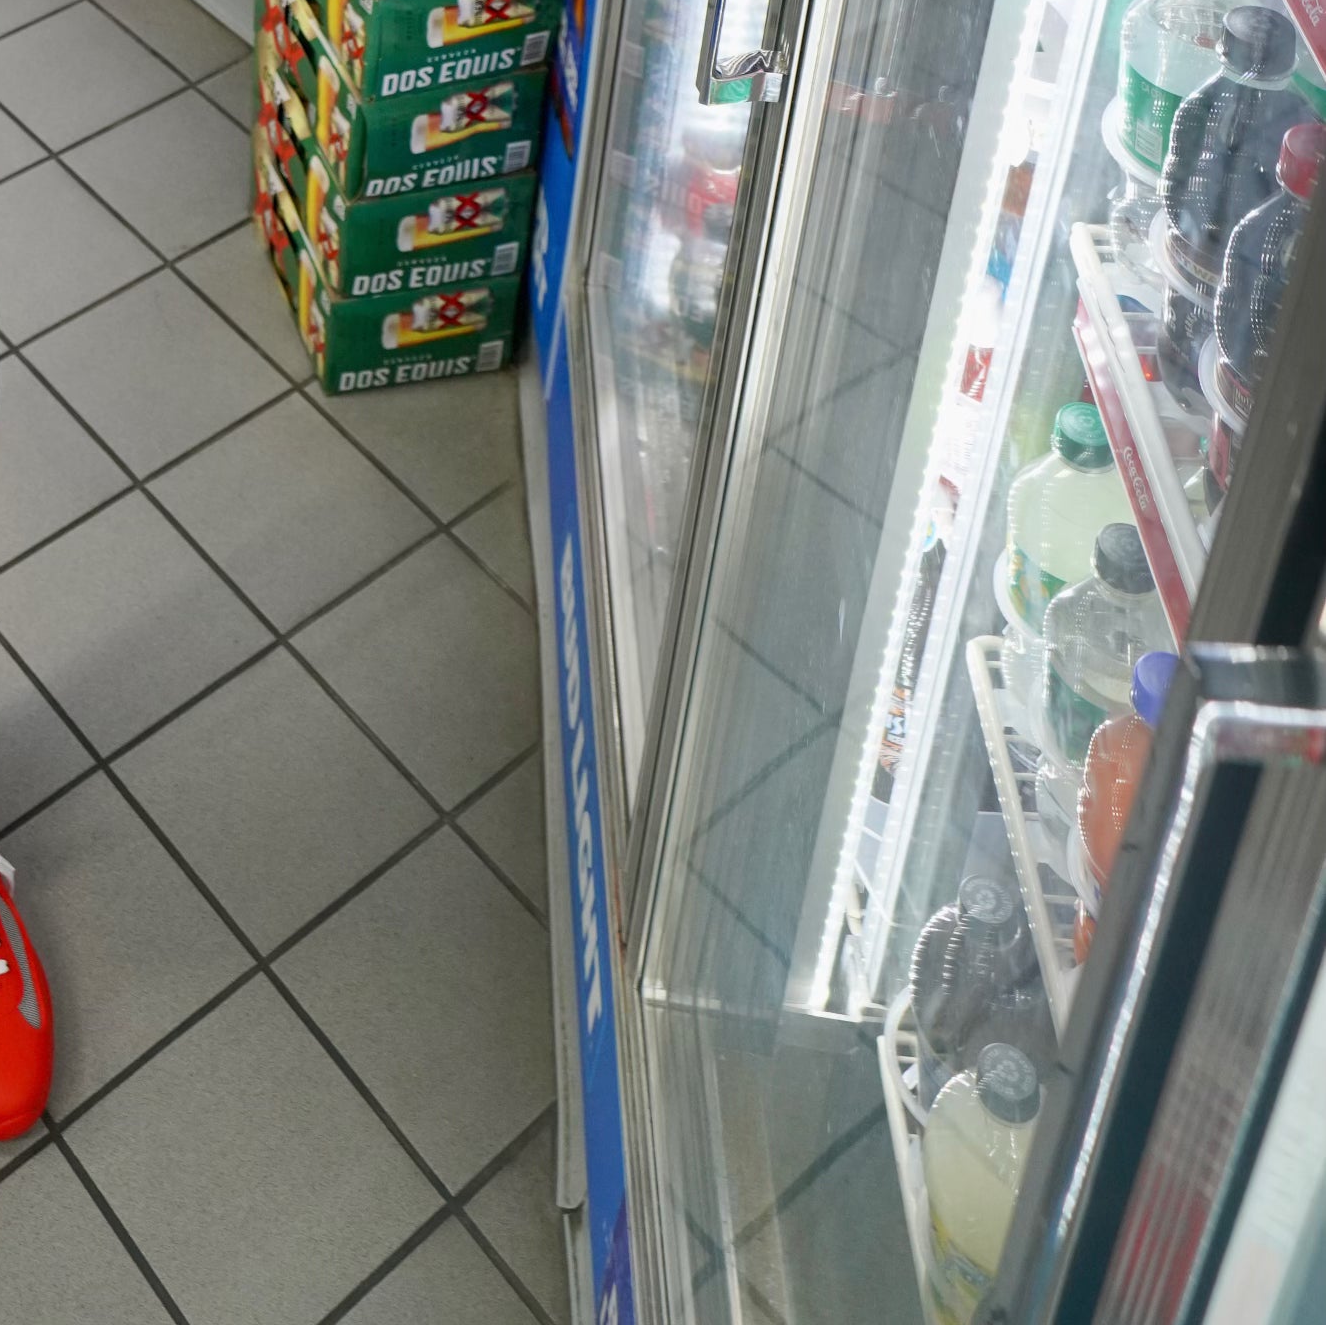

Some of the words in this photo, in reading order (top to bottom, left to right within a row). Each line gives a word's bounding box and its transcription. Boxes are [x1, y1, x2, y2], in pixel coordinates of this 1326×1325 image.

[381, 65, 435, 97] DOS
[439, 48, 516, 83] EQUIS
[365, 172, 418, 198] DOS
[421, 156, 499, 187] EQUIS
[351, 269, 405, 296] DOS
[409, 258, 487, 289] EQUIS
[339, 367, 391, 392] DOS
[395, 355, 472, 388] EQUIS
[1124, 445, 1151, 511] Coca-Cola
